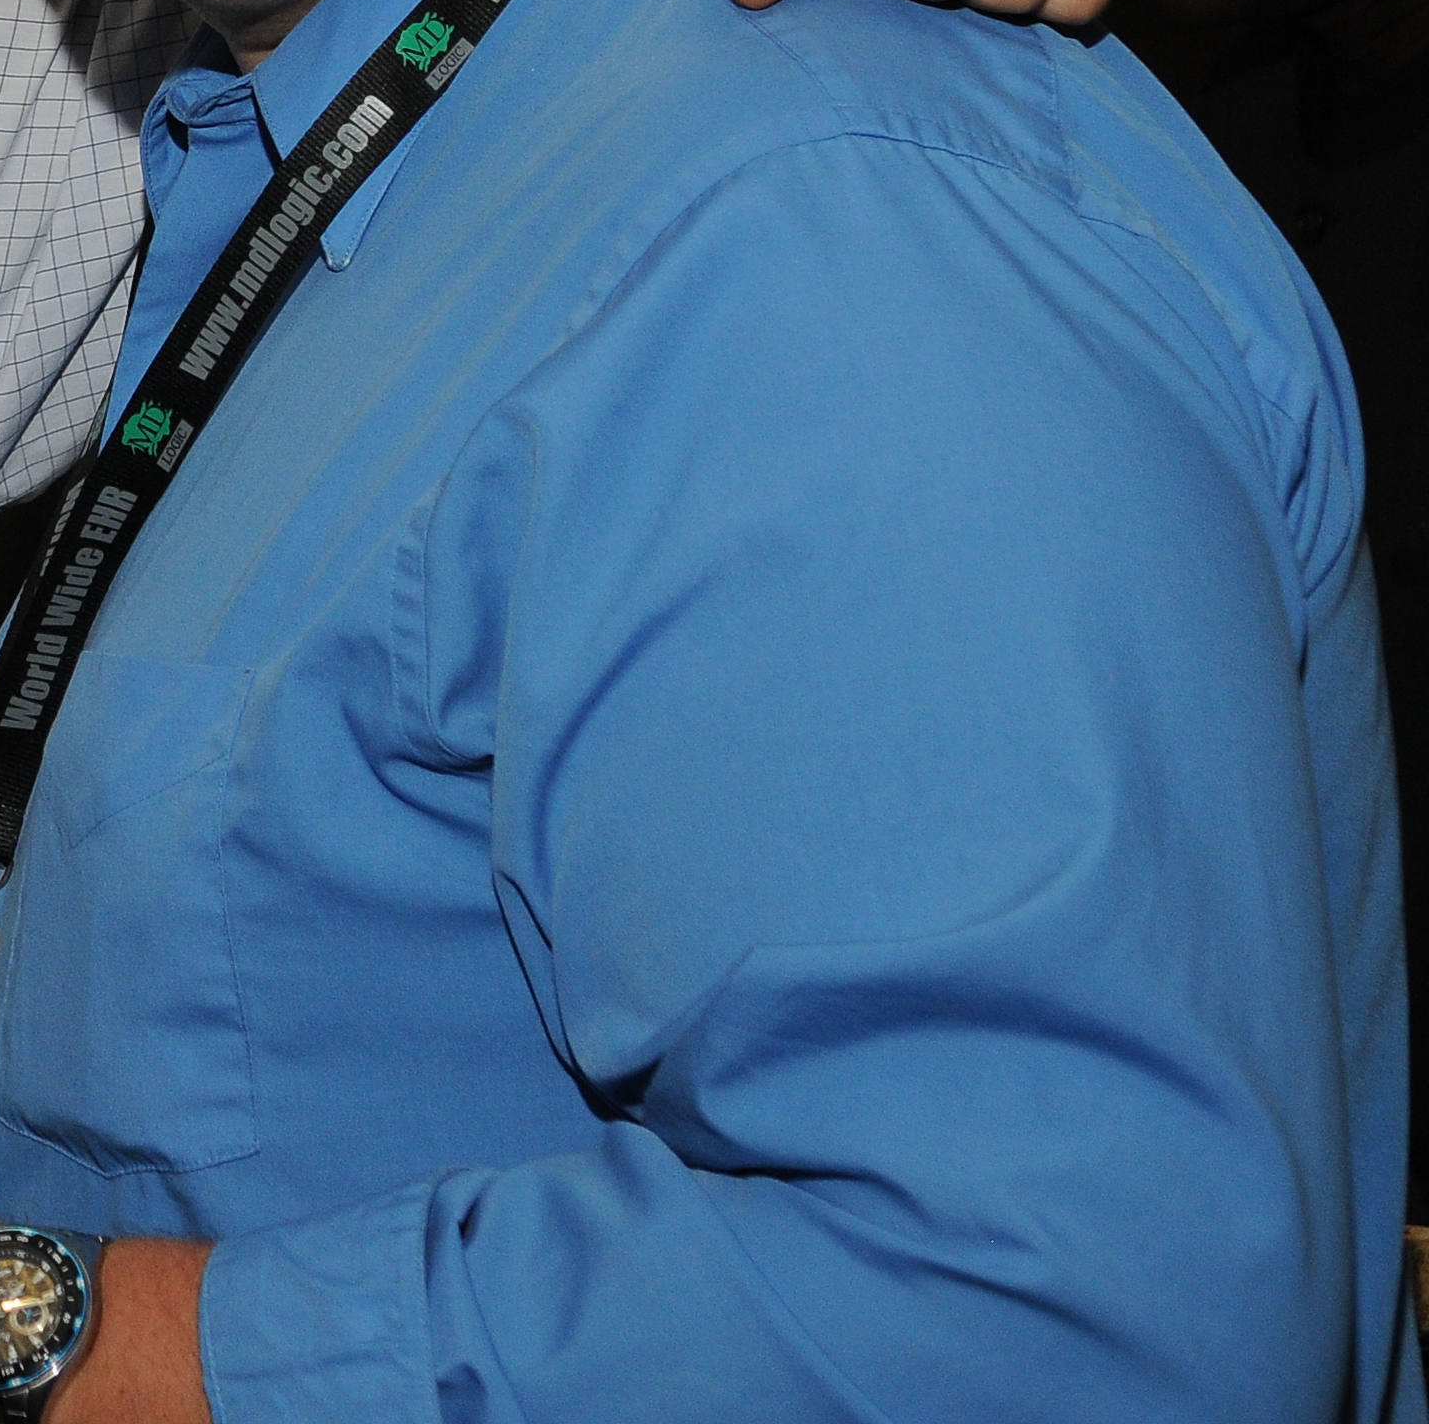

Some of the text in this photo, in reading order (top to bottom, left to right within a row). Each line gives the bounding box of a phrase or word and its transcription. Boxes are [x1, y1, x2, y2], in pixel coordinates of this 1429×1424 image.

[403, 18, 448, 63] MD
[431, 44, 467, 86] LOGIC
[178, 94, 394, 381] www.mdlogic.com
[127, 405, 168, 451] MD
[160, 421, 190, 467] LOGIC
[0, 632, 69, 731] World
[40, 547, 105, 626] Wide
[79, 485, 139, 544] EHR
